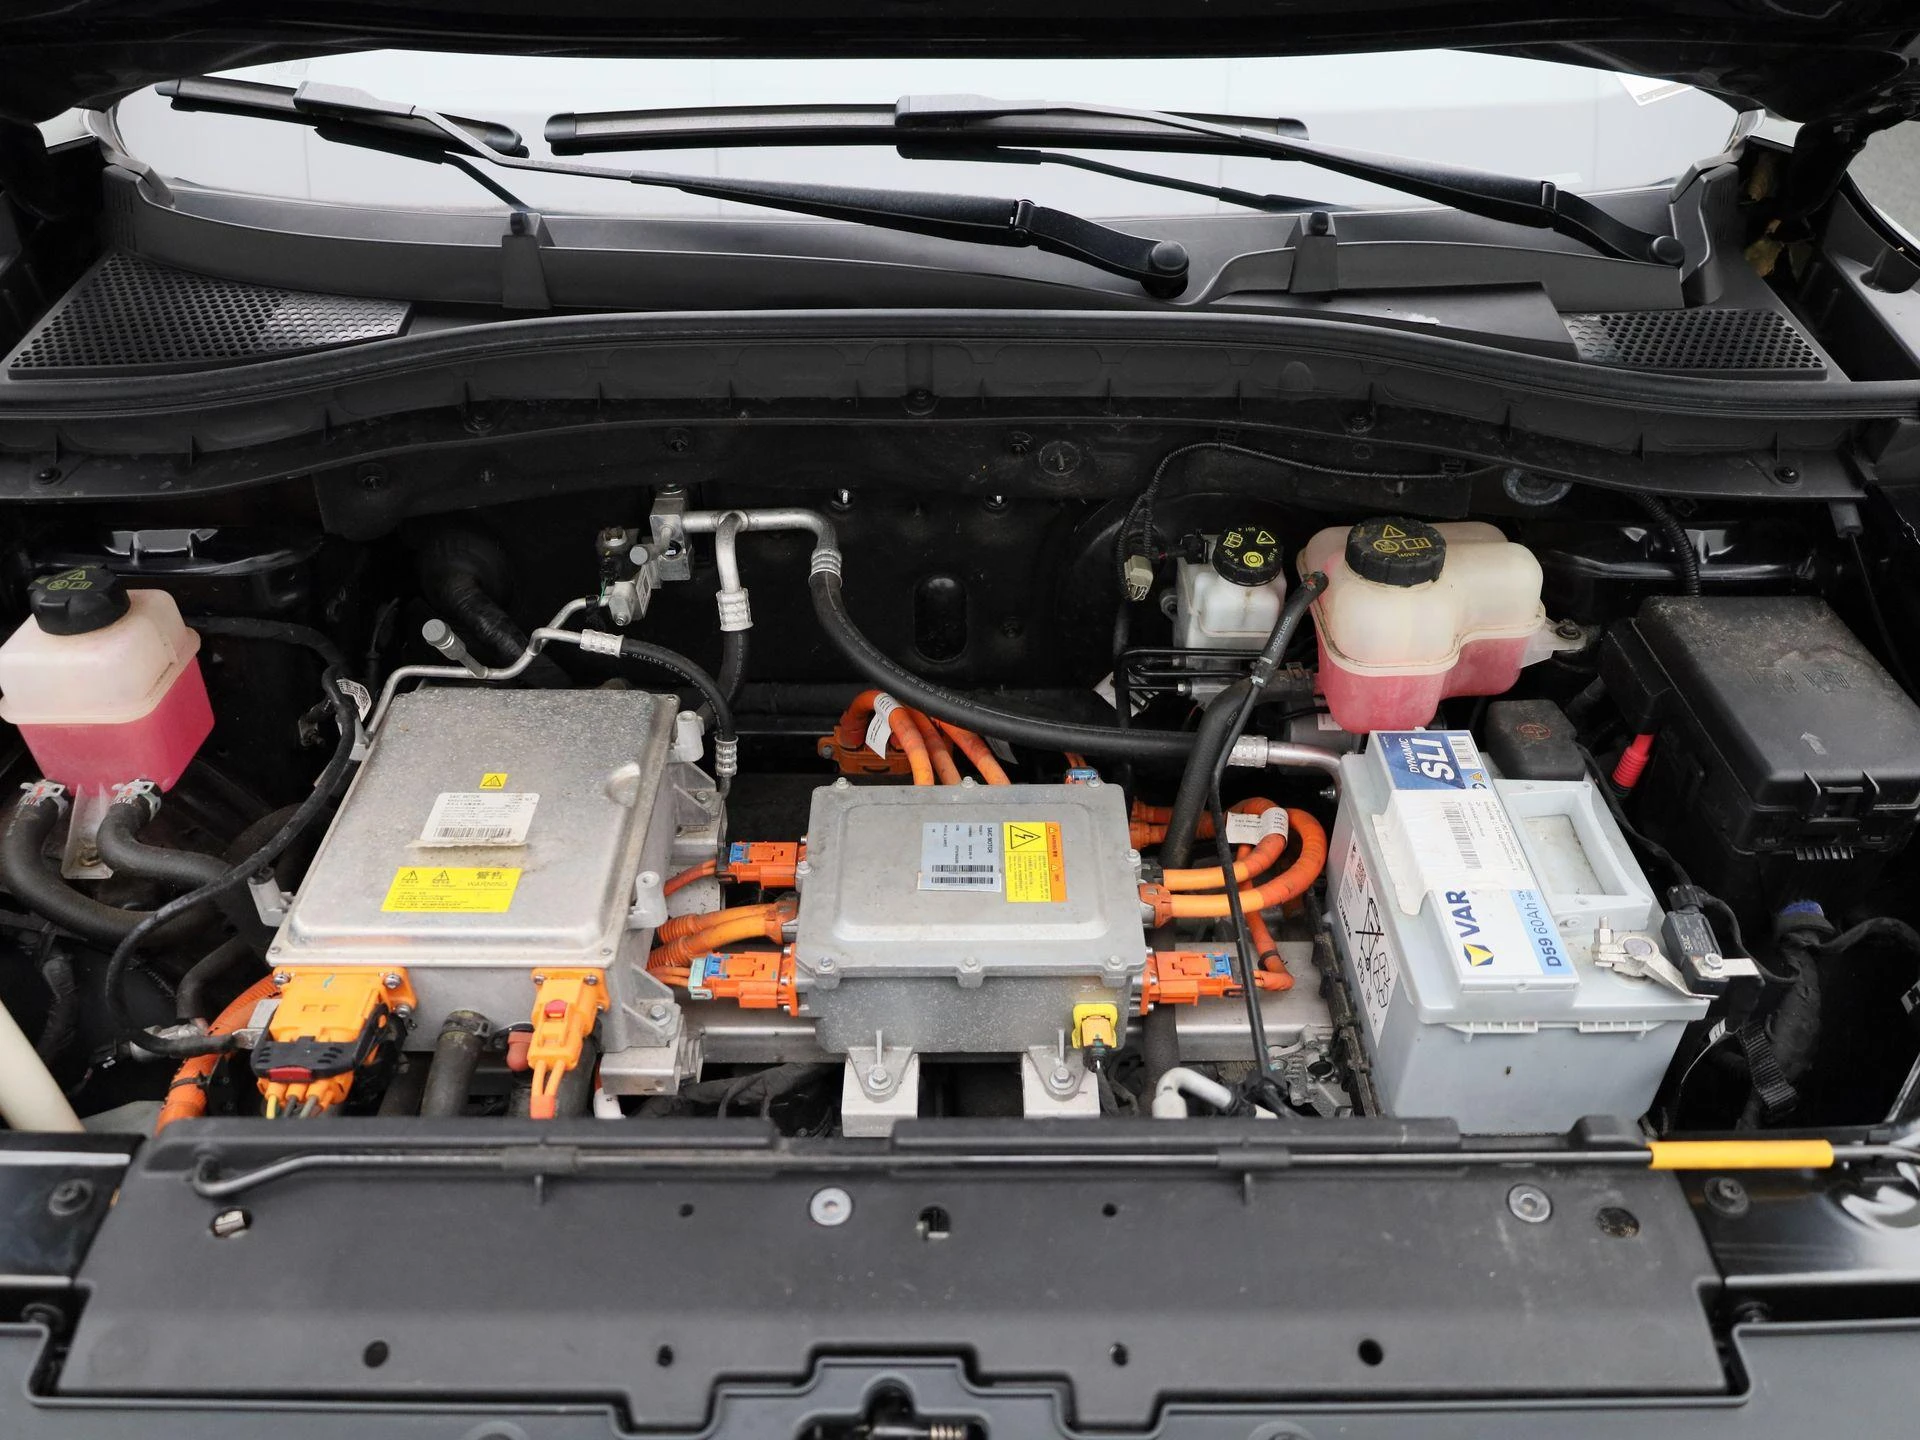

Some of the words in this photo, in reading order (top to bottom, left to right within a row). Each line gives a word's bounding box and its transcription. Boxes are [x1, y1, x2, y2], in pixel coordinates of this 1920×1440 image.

[632, 653, 664, 665] GALAXY
[936, 690, 972, 708] GALAXY
[1398, 737, 1421, 774] DYNAMIC
[1410, 737, 1456, 781] SLI
[1524, 902, 1548, 935] 60Ah
[1538, 937, 1563, 967] D59
